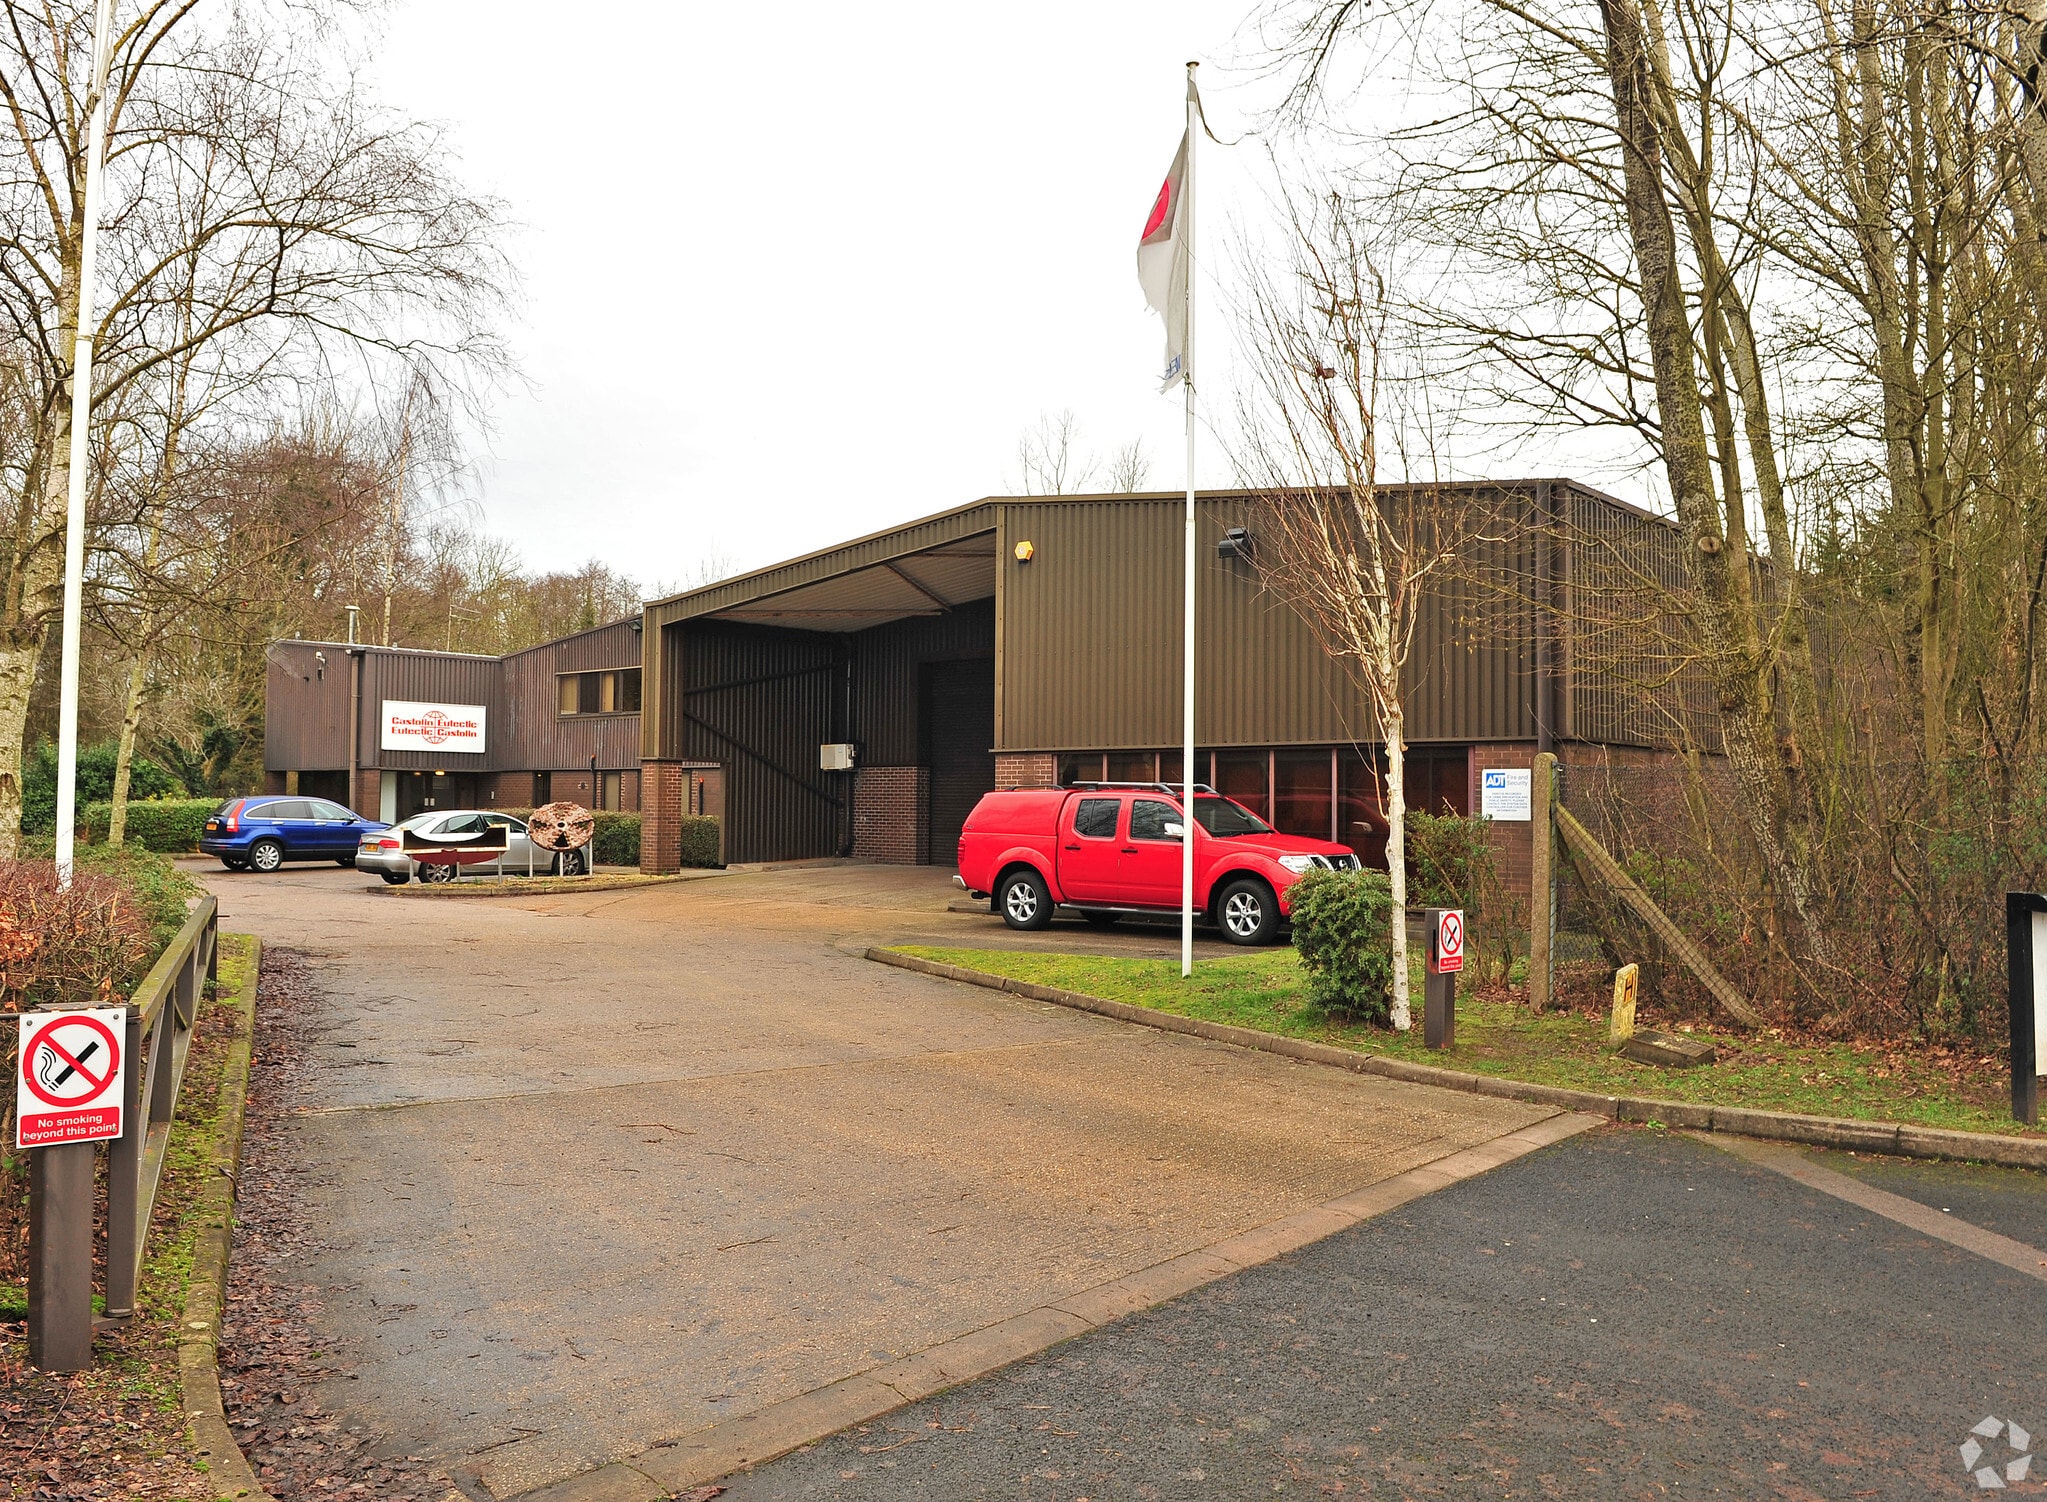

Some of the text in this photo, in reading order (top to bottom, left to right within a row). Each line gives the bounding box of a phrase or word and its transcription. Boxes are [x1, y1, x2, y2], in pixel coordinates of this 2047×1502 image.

[391, 716, 478, 729] Castolin Eutectic
[391, 726, 477, 737] Eutectic Castolin
[1486, 774, 1506, 787] ADT
[37, 1114, 103, 1128] No smoking
[22, 1122, 117, 1141] beyond this point
